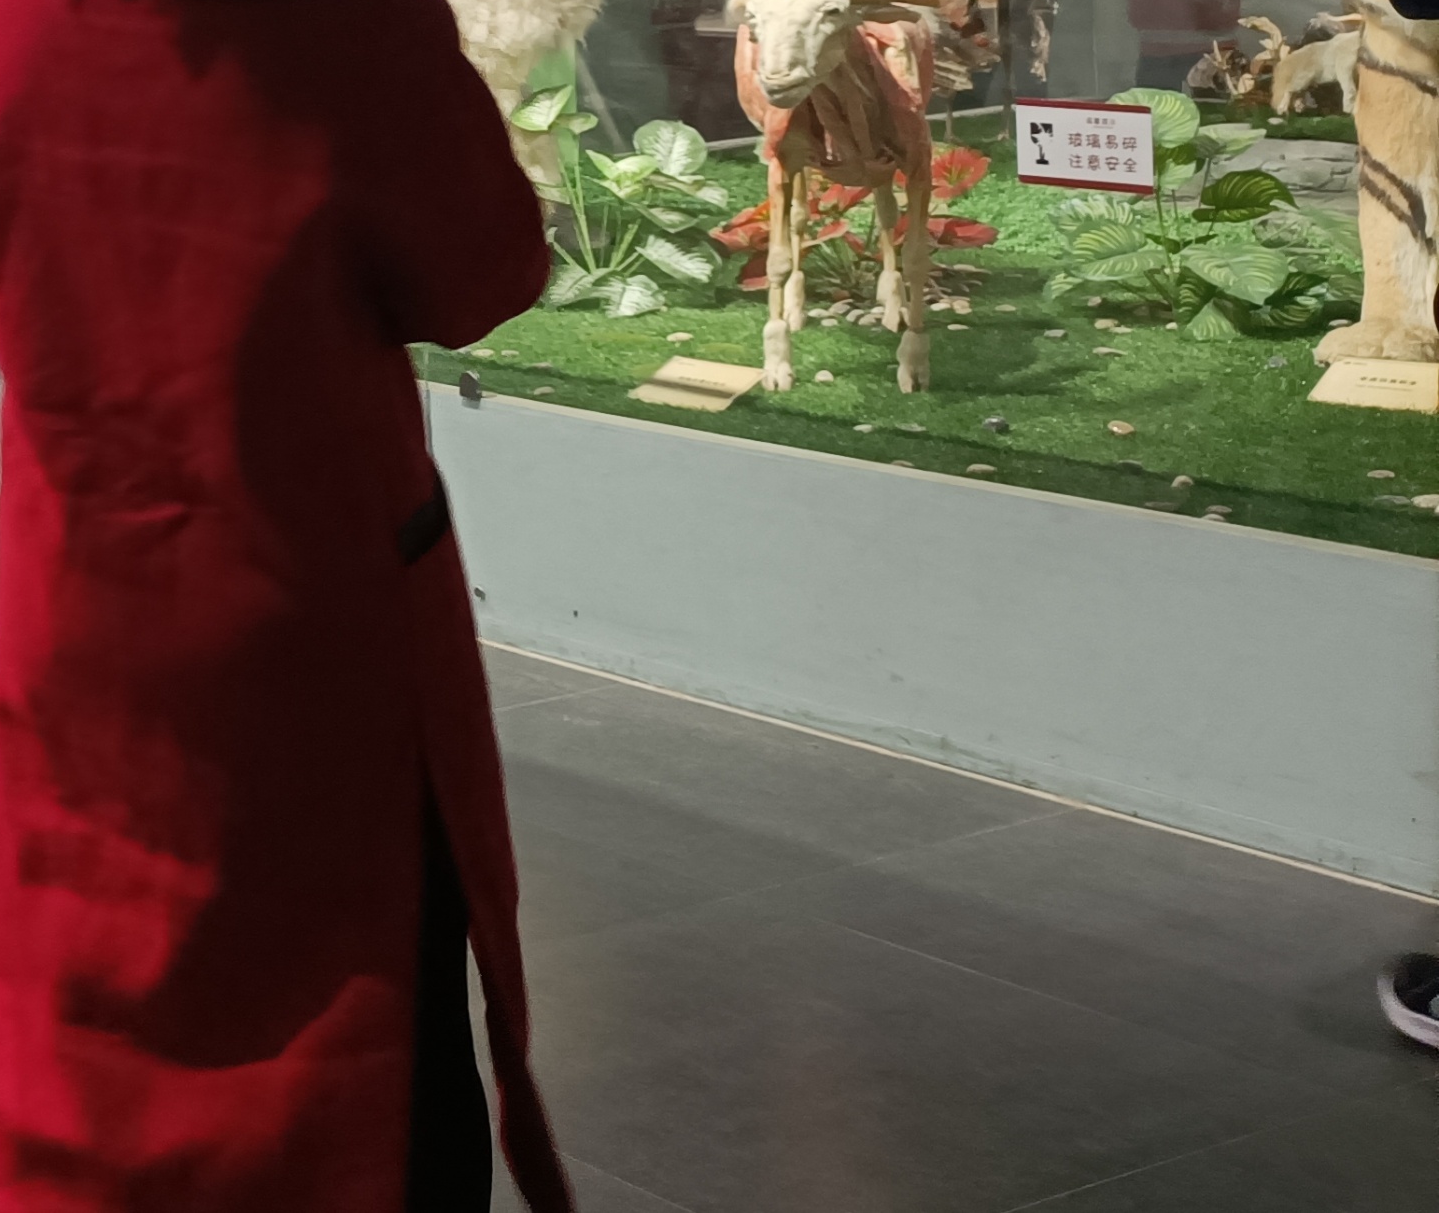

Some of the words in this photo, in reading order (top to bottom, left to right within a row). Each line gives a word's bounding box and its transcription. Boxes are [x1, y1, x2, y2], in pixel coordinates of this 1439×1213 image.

[1067, 132, 1138, 152] 玻璃易碎
[1067, 154, 1138, 173] 注意安全
